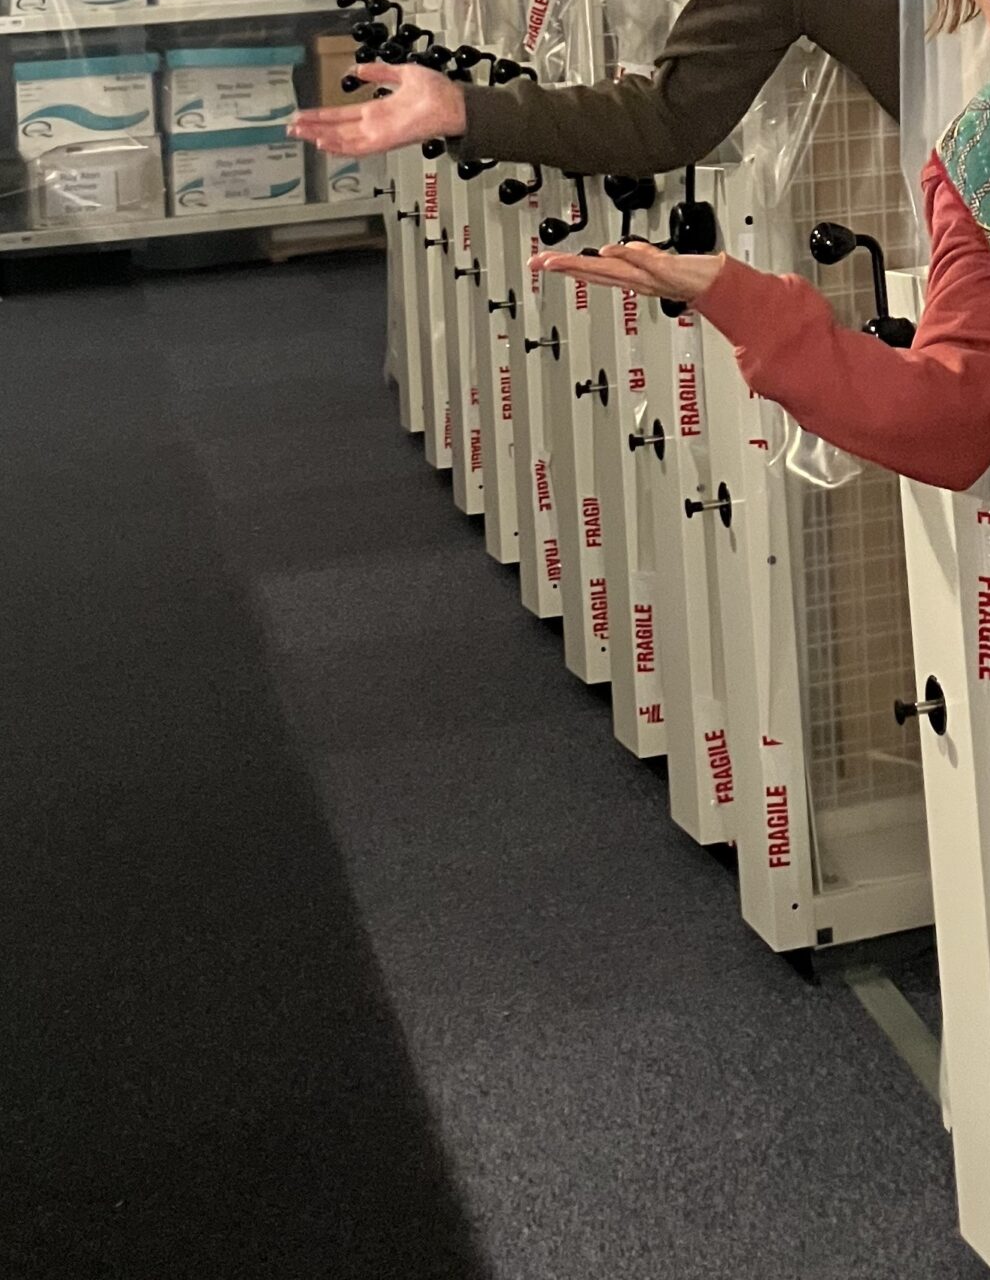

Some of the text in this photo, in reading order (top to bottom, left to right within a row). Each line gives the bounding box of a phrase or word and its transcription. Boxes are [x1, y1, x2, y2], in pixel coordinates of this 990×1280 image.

[425, 173, 438, 219] FRAGILE
[678, 363, 701, 437] FRAGILE
[590, 577, 610, 640] FRAGILE
[634, 603, 655, 674] FRAGILE
[704, 729, 735, 805] FRAGILE
[766, 785, 792, 869] FRAGILE
